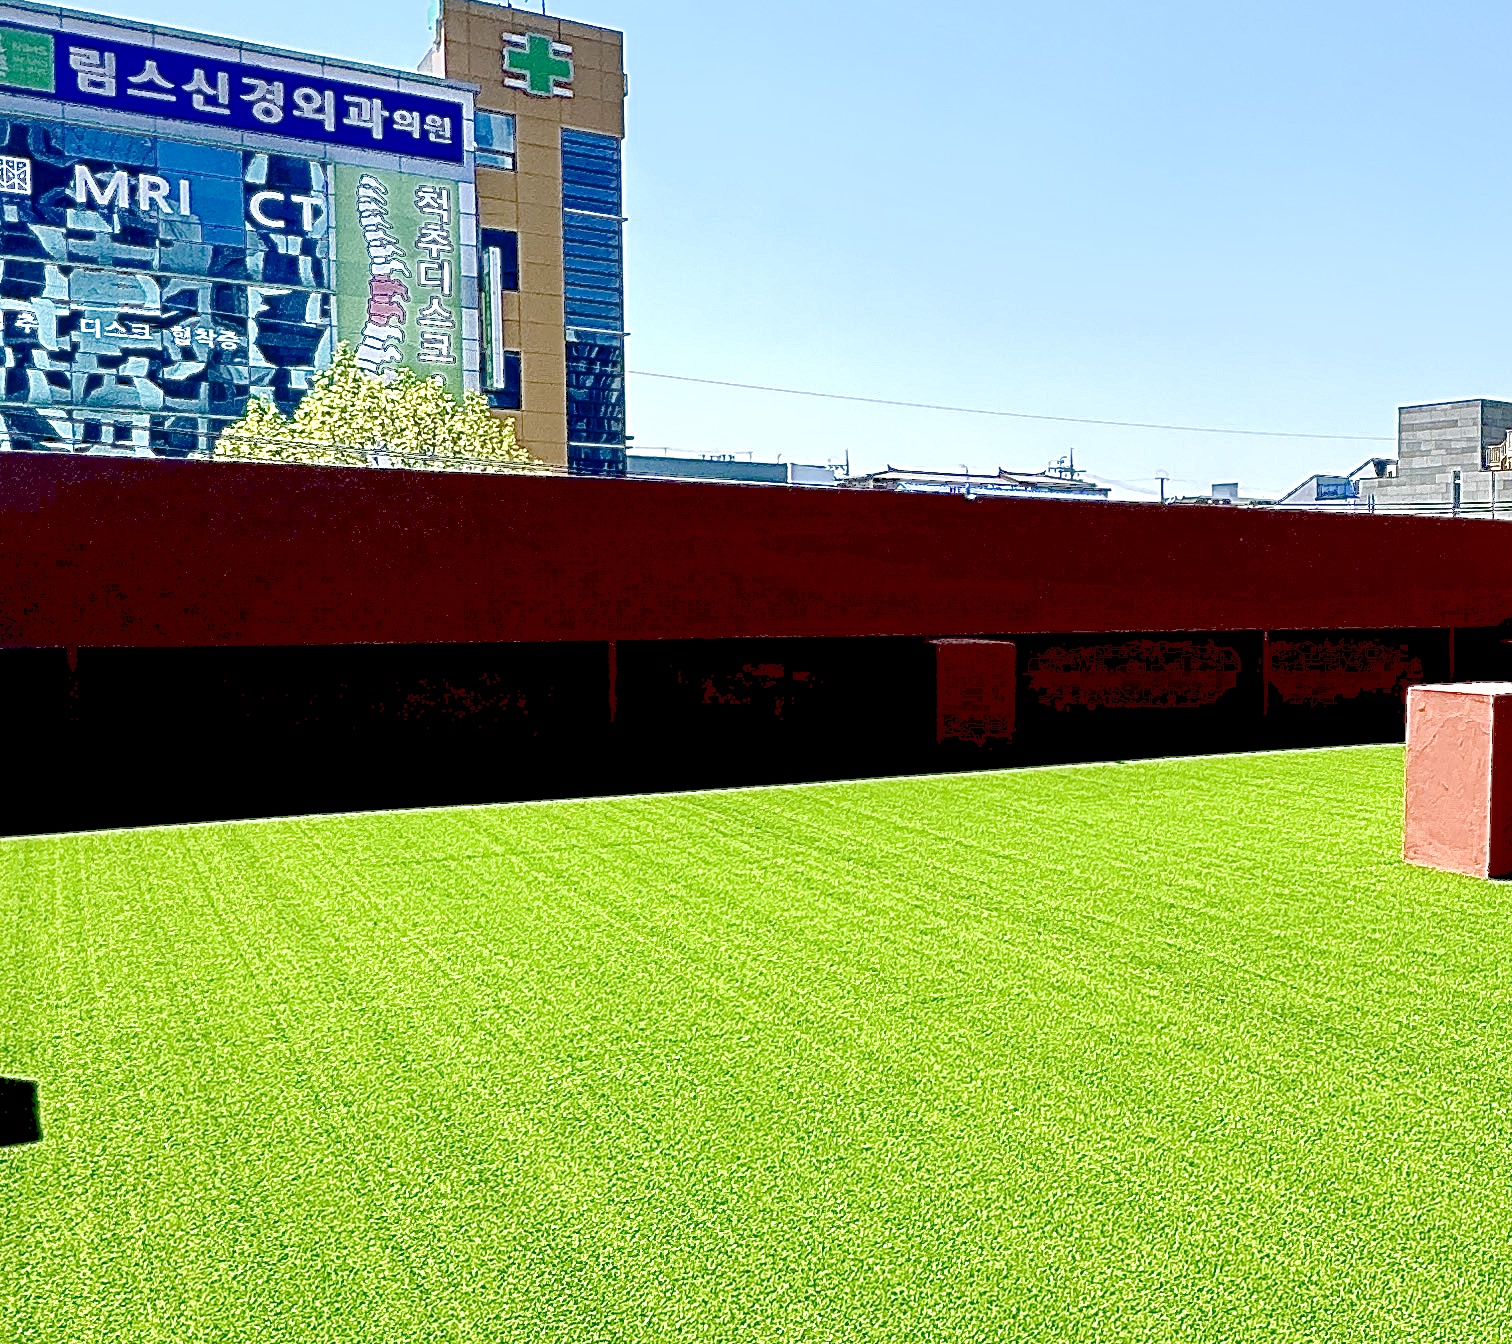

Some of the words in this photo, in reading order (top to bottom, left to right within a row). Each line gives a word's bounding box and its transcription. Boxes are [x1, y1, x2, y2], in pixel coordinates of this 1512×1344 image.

[73, 164, 191, 216] MRI
[250, 191, 325, 232] CT
[80, 318, 153, 339] 디스크
[170, 325, 241, 350] 협착증
